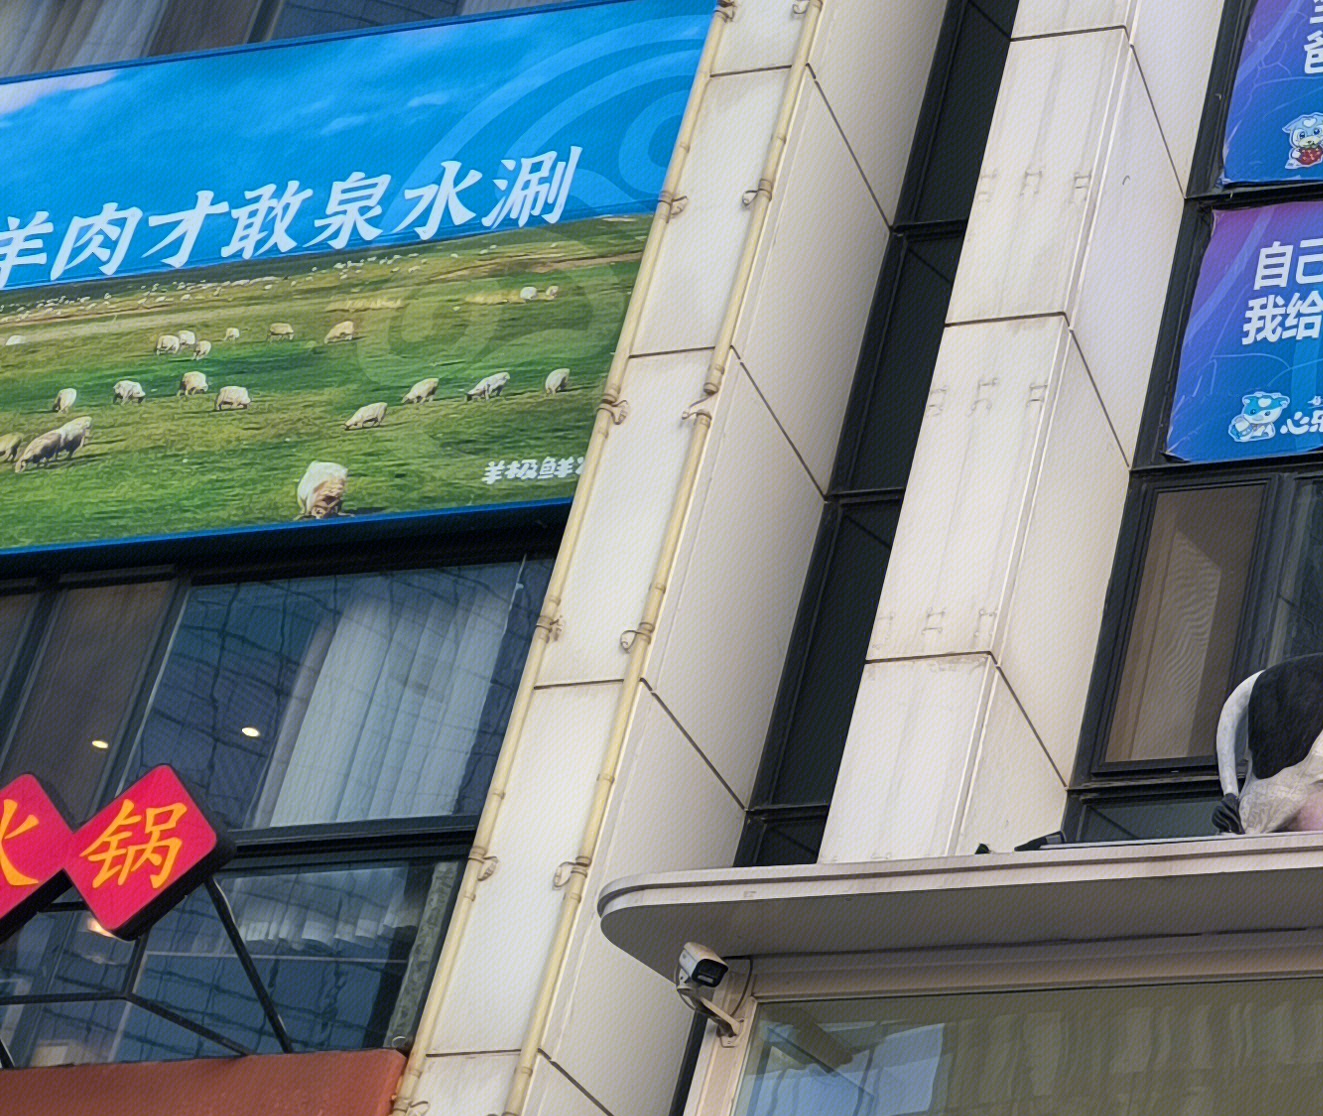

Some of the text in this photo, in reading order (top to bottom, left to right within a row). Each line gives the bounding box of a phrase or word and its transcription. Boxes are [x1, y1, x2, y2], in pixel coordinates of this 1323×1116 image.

[0, 145, 582, 289] 羊肉才敢泉水涮
